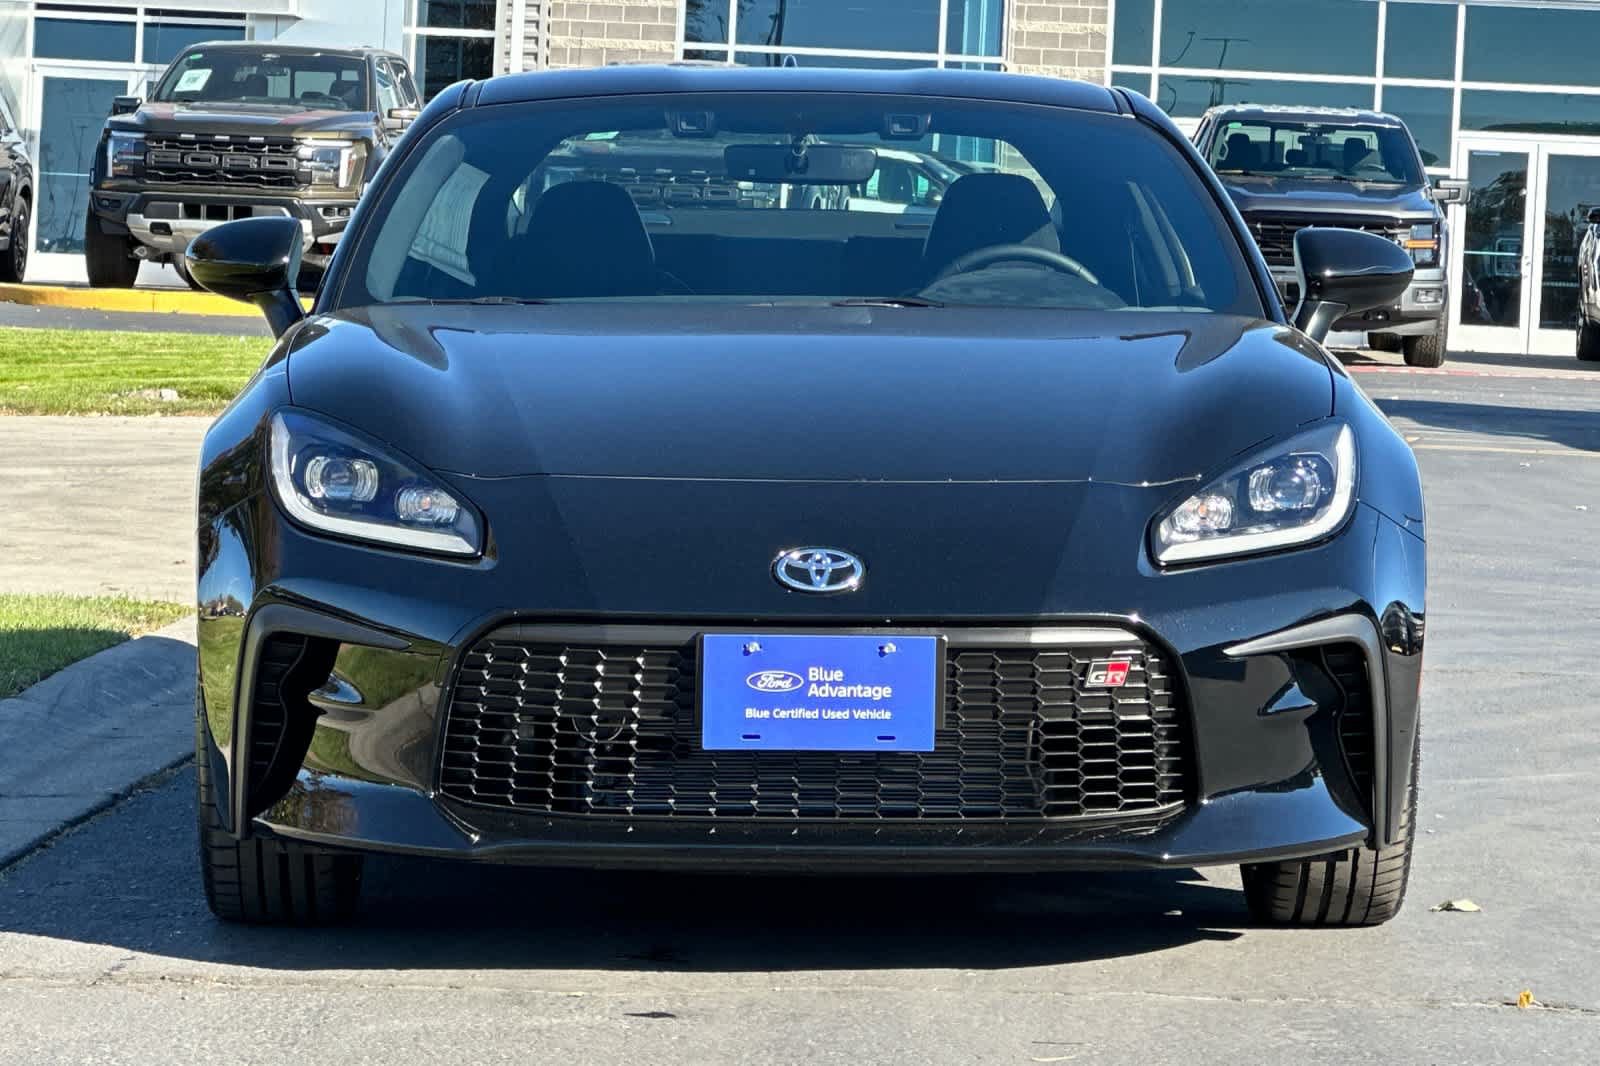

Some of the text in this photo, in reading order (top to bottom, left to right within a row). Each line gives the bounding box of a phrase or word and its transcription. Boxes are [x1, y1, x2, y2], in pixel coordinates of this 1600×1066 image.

[148, 151, 299, 170] FORD
[757, 673, 792, 690] Ford
[808, 667, 843, 682] Blue
[1090, 671, 1125, 683] GR
[808, 684, 892, 700] Advantage
[745, 708, 892, 720] Blue Certified Used Vehicle
